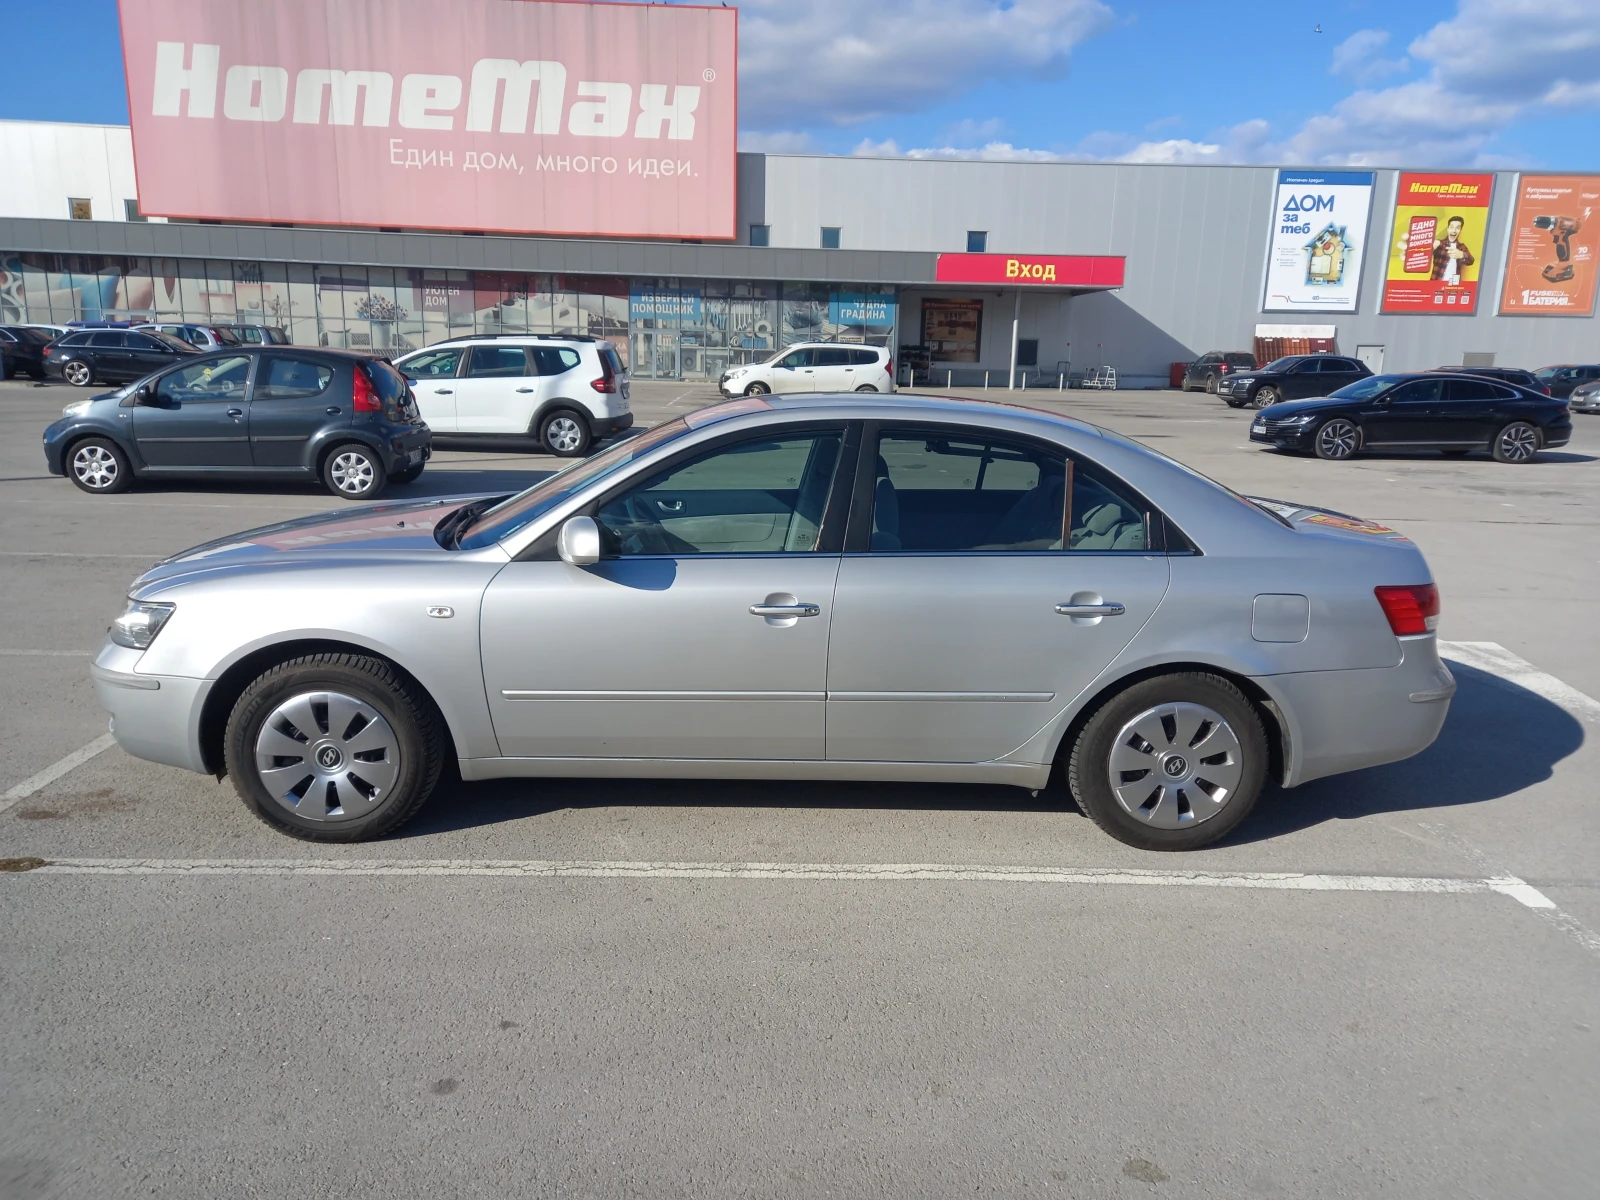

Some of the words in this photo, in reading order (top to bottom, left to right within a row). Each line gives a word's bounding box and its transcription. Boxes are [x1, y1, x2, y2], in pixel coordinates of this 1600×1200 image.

[151, 41, 702, 141] HomeMax
[389, 138, 454, 169] Един
[463, 151, 524, 175] дом,
[535, 153, 618, 174] много
[628, 157, 699, 179] идеи.
[1410, 183, 1478, 194] HomeMax
[1283, 214, 1298, 222] за
[1281, 222, 1311, 234] теб
[1411, 220, 1435, 230] ЕДНО
[1410, 232, 1433, 241] МНОГО
[1006, 259, 1056, 281] Вход
[425, 296, 447, 306] ДОМ
[632, 303, 694, 316] ПОМОЩНИК
[840, 309, 886, 320] ГРАДИНА
